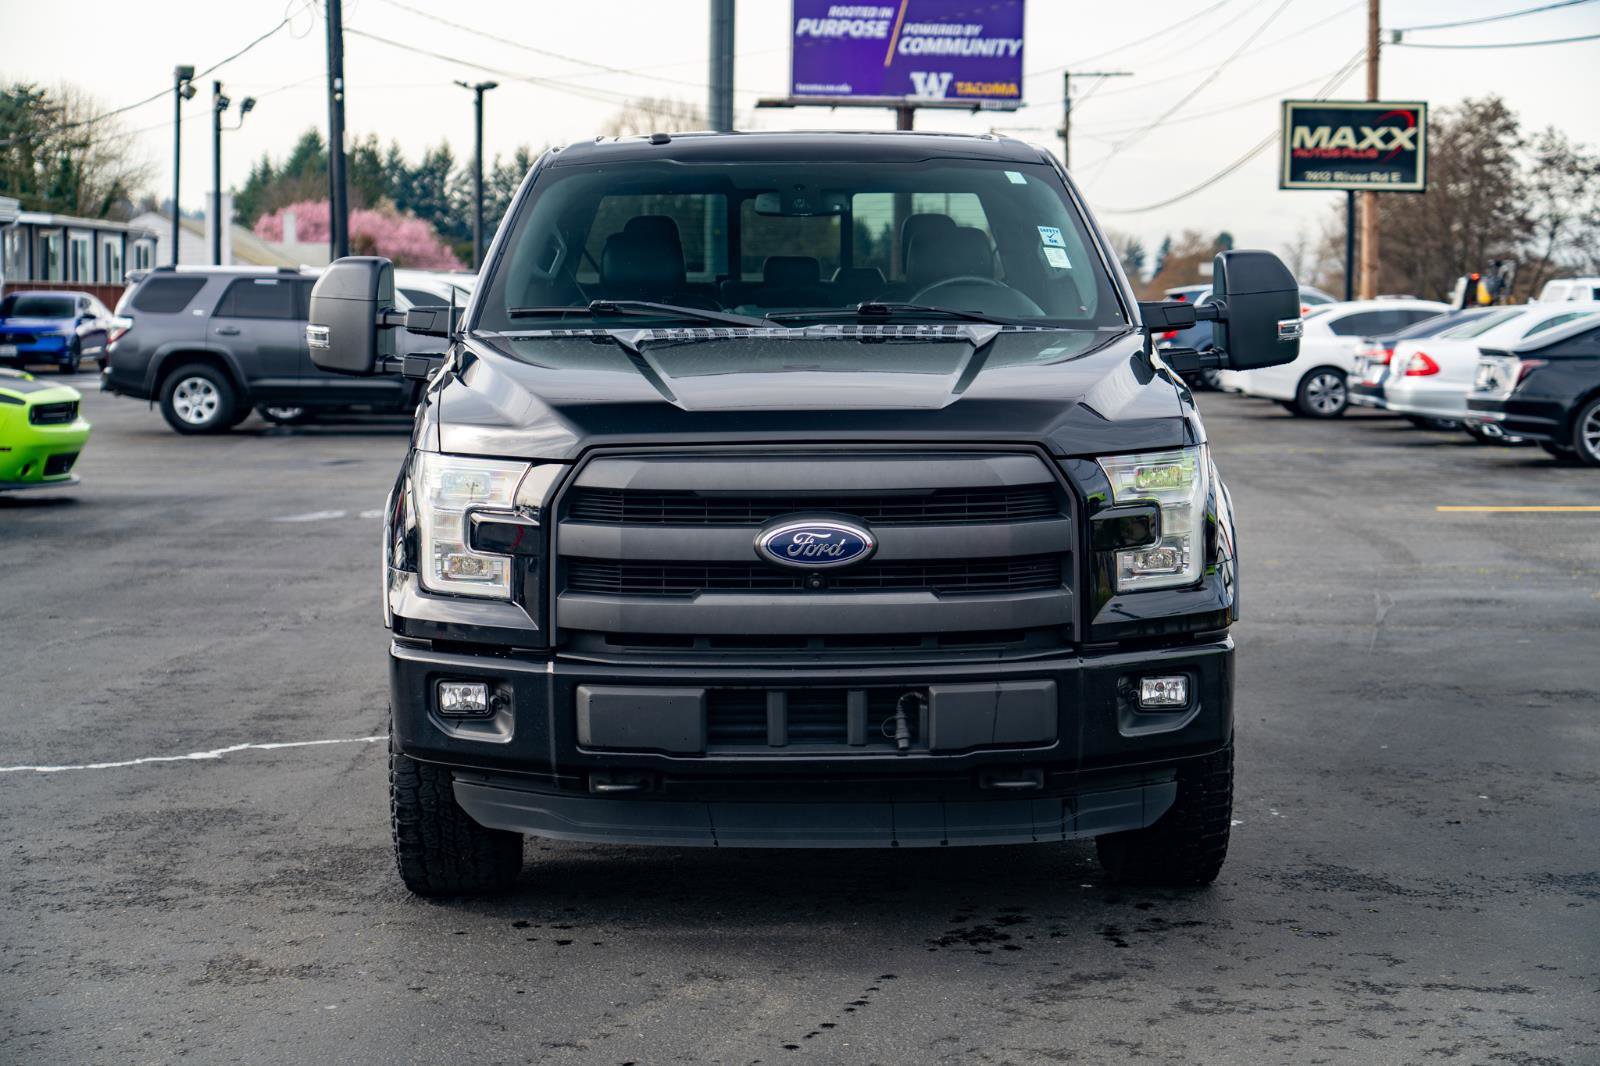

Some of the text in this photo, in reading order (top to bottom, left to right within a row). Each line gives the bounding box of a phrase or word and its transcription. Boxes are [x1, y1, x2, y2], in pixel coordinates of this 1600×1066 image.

[828, 6, 878, 18] ROOTED
[796, 18, 890, 38] PURPOSE
[902, 23, 983, 36] POWERED BY
[898, 37, 1022, 57] COMMUNITY
[909, 72, 954, 98] W
[956, 81, 1018, 96] TACOMA
[1292, 126, 1418, 150] MAXX
[1369, 171, 1389, 183] Rd
[1391, 171, 1401, 183] E
[787, 532, 846, 557] Ford
